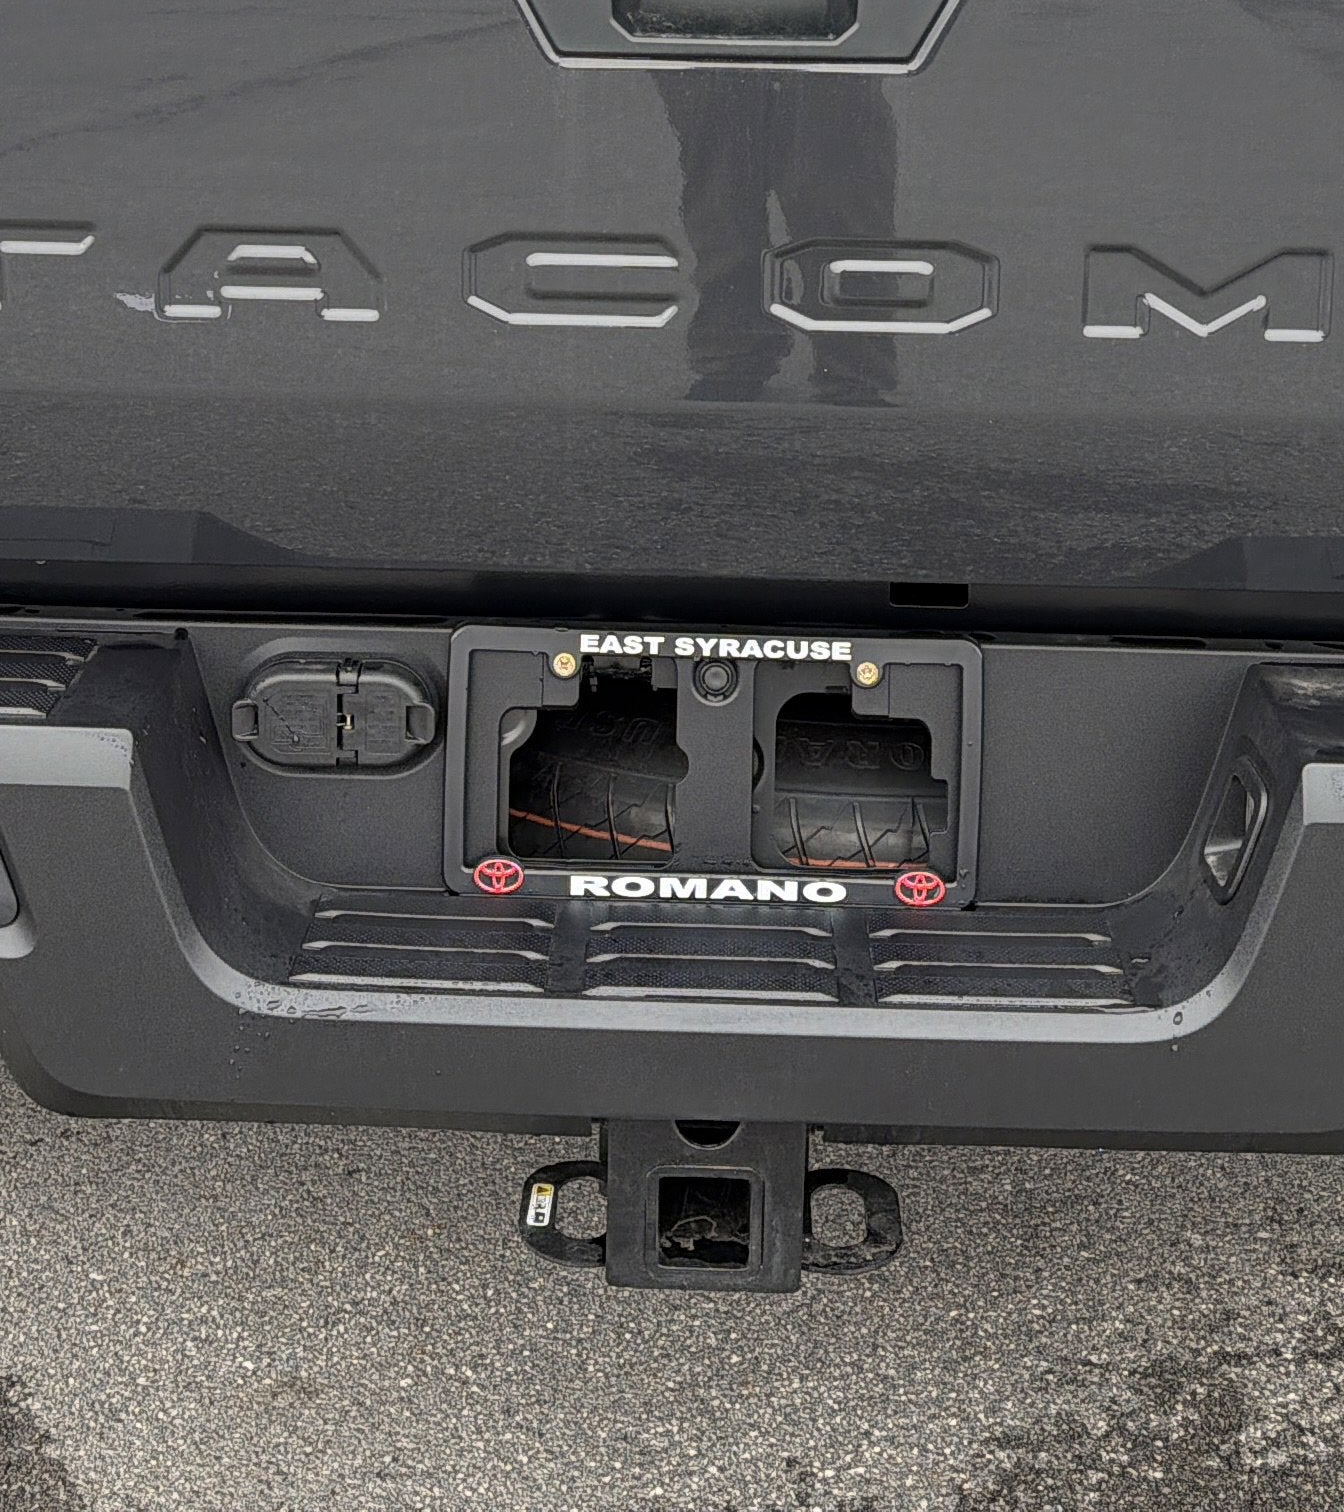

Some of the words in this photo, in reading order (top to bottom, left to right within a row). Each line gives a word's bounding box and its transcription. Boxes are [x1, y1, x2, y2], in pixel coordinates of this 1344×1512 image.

[580, 633, 665, 655] EAST
[674, 637, 853, 661] SYRACUSE
[569, 875, 848, 903] ROMANO
